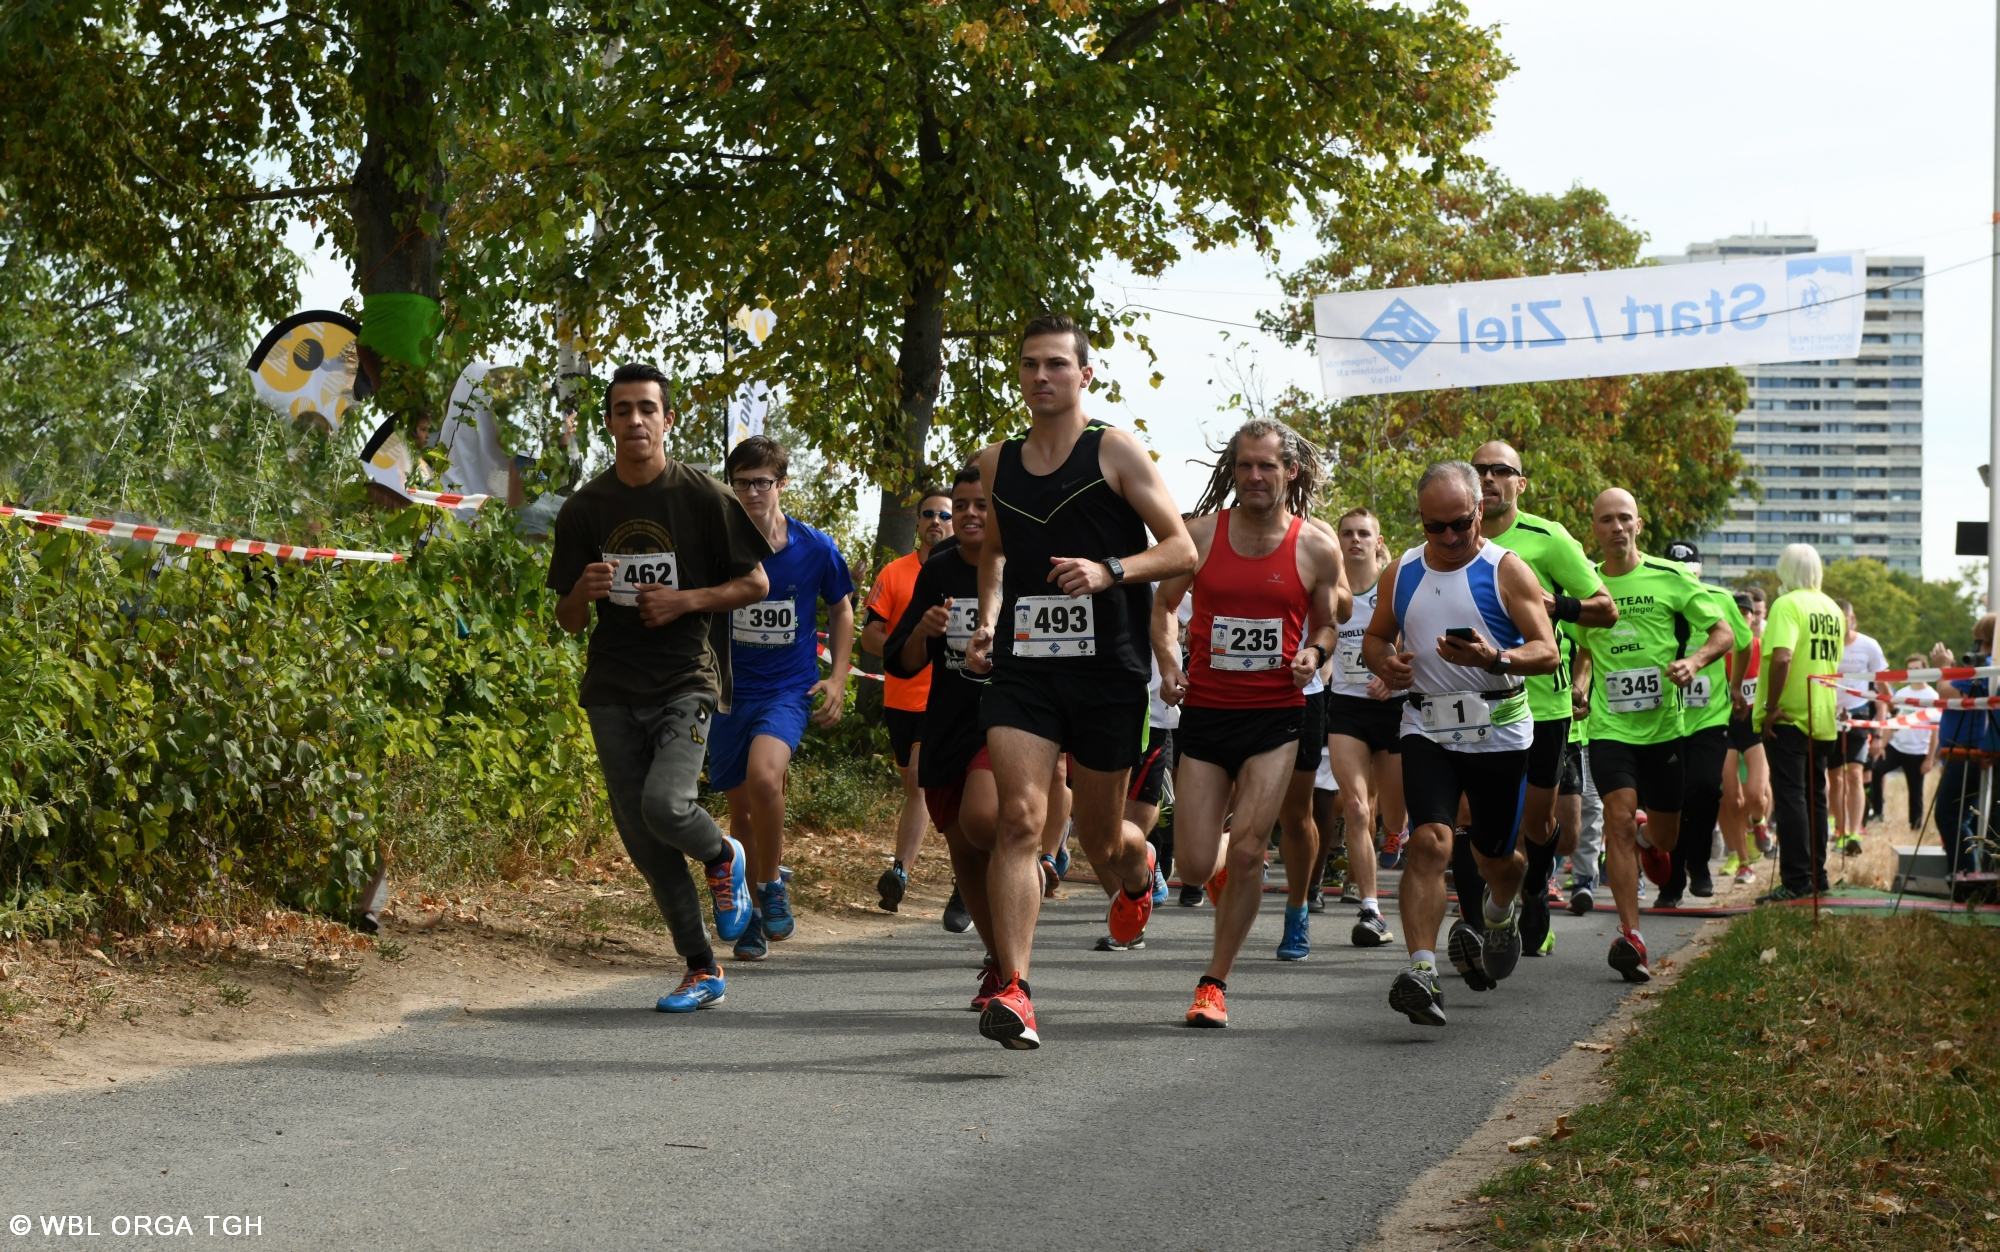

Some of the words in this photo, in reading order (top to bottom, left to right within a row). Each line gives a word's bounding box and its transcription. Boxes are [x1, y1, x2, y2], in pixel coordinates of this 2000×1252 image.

[624, 562, 672, 586] 462
[750, 608, 791, 627] 390
[1034, 605, 1088, 634] 493
[1629, 605, 1655, 615] Heger
[1809, 612, 1840, 638] ORGA
[1230, 627, 1278, 651] 235
[1610, 642, 1645, 655] OPEL
[1620, 673, 1659, 696] 345
[1686, 681, 1703, 696] 14
[1452, 699, 1465, 723] 1
